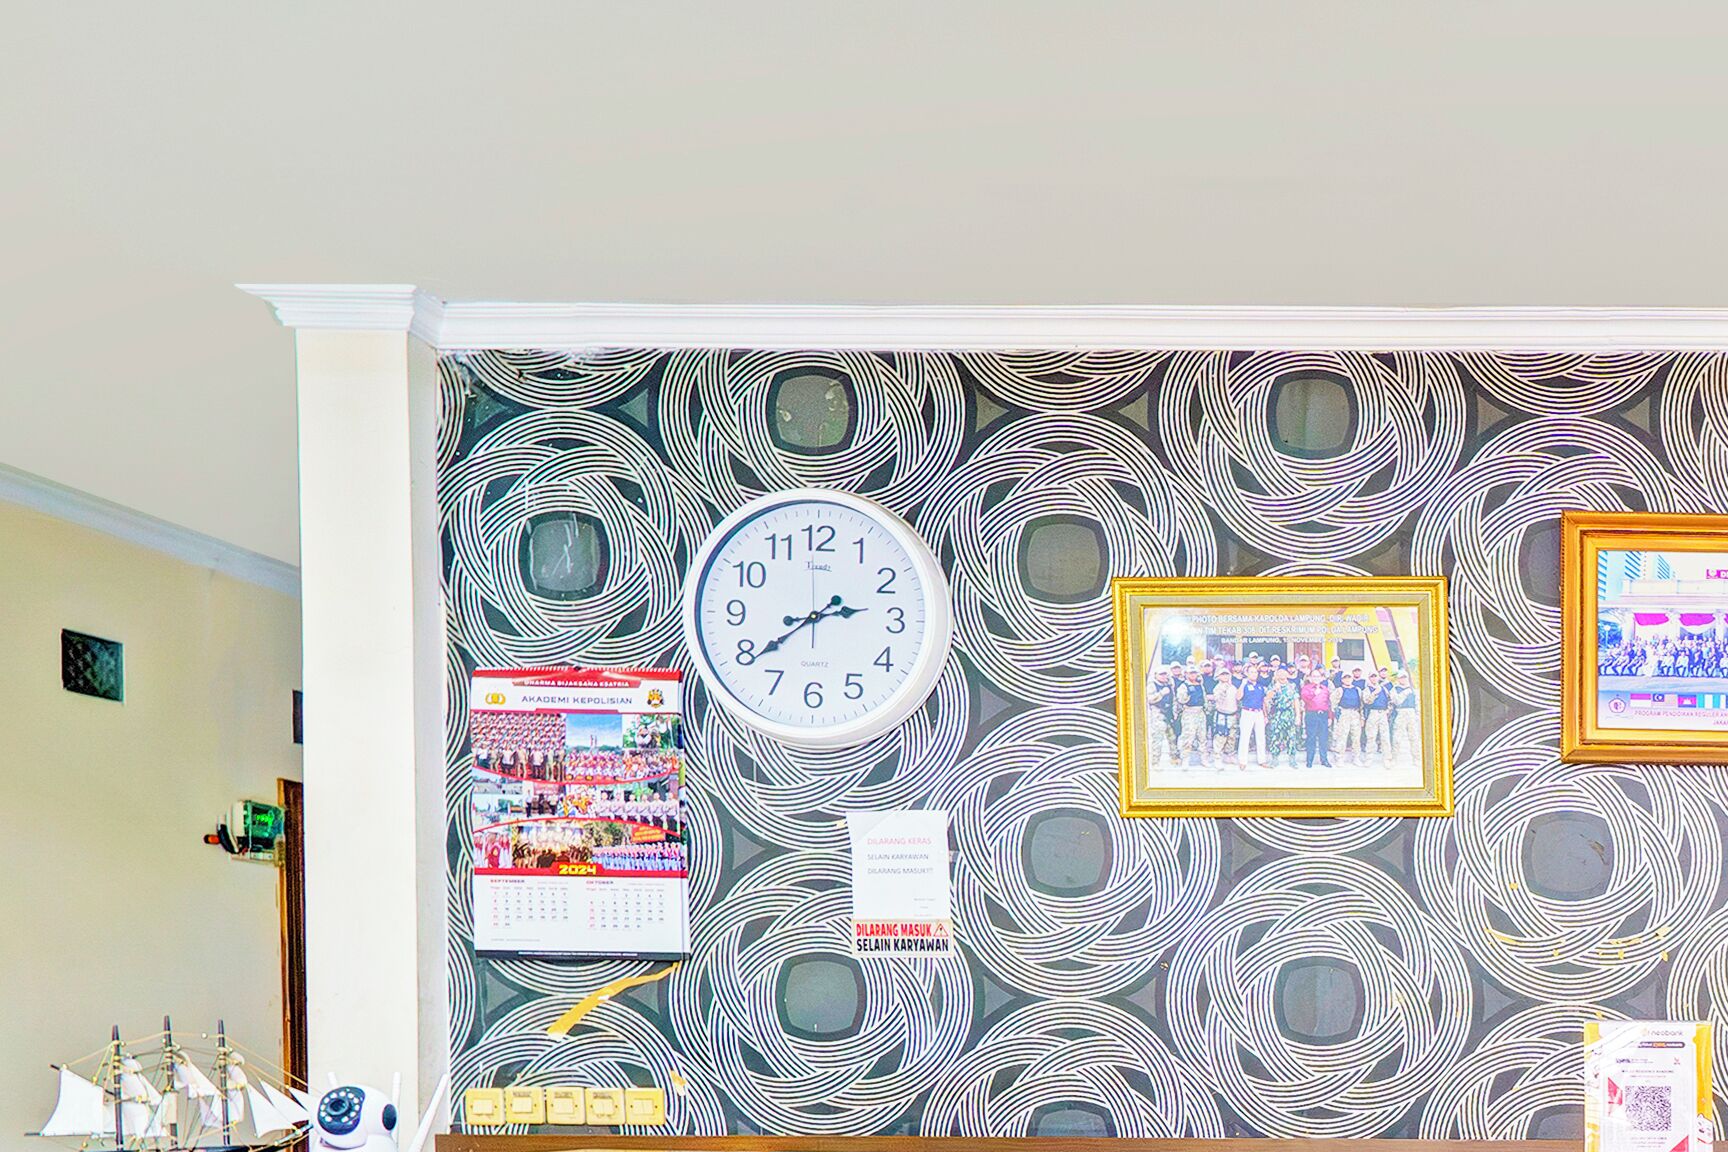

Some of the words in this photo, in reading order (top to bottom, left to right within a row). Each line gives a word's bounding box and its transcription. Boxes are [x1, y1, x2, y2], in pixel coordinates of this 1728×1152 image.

[763, 533, 793, 561] 11
[801, 524, 836, 552] 12
[852, 537, 865, 564] 1
[732, 560, 767, 588] 10
[876, 567, 897, 594] 2
[726, 599, 746, 626] 9
[885, 606, 906, 634] 3
[735, 639, 755, 666] 8
[872, 646, 894, 673] 4
[764, 669, 785, 696] 7
[803, 681, 824, 708] 6
[843, 672, 864, 700] 5
[558, 864, 597, 875] 2024
[856, 923, 898, 937] DILARANG
[900, 923, 932, 937] MASUK
[857, 939, 891, 951] SELAIN
[894, 939, 949, 951] KARYAWAN
